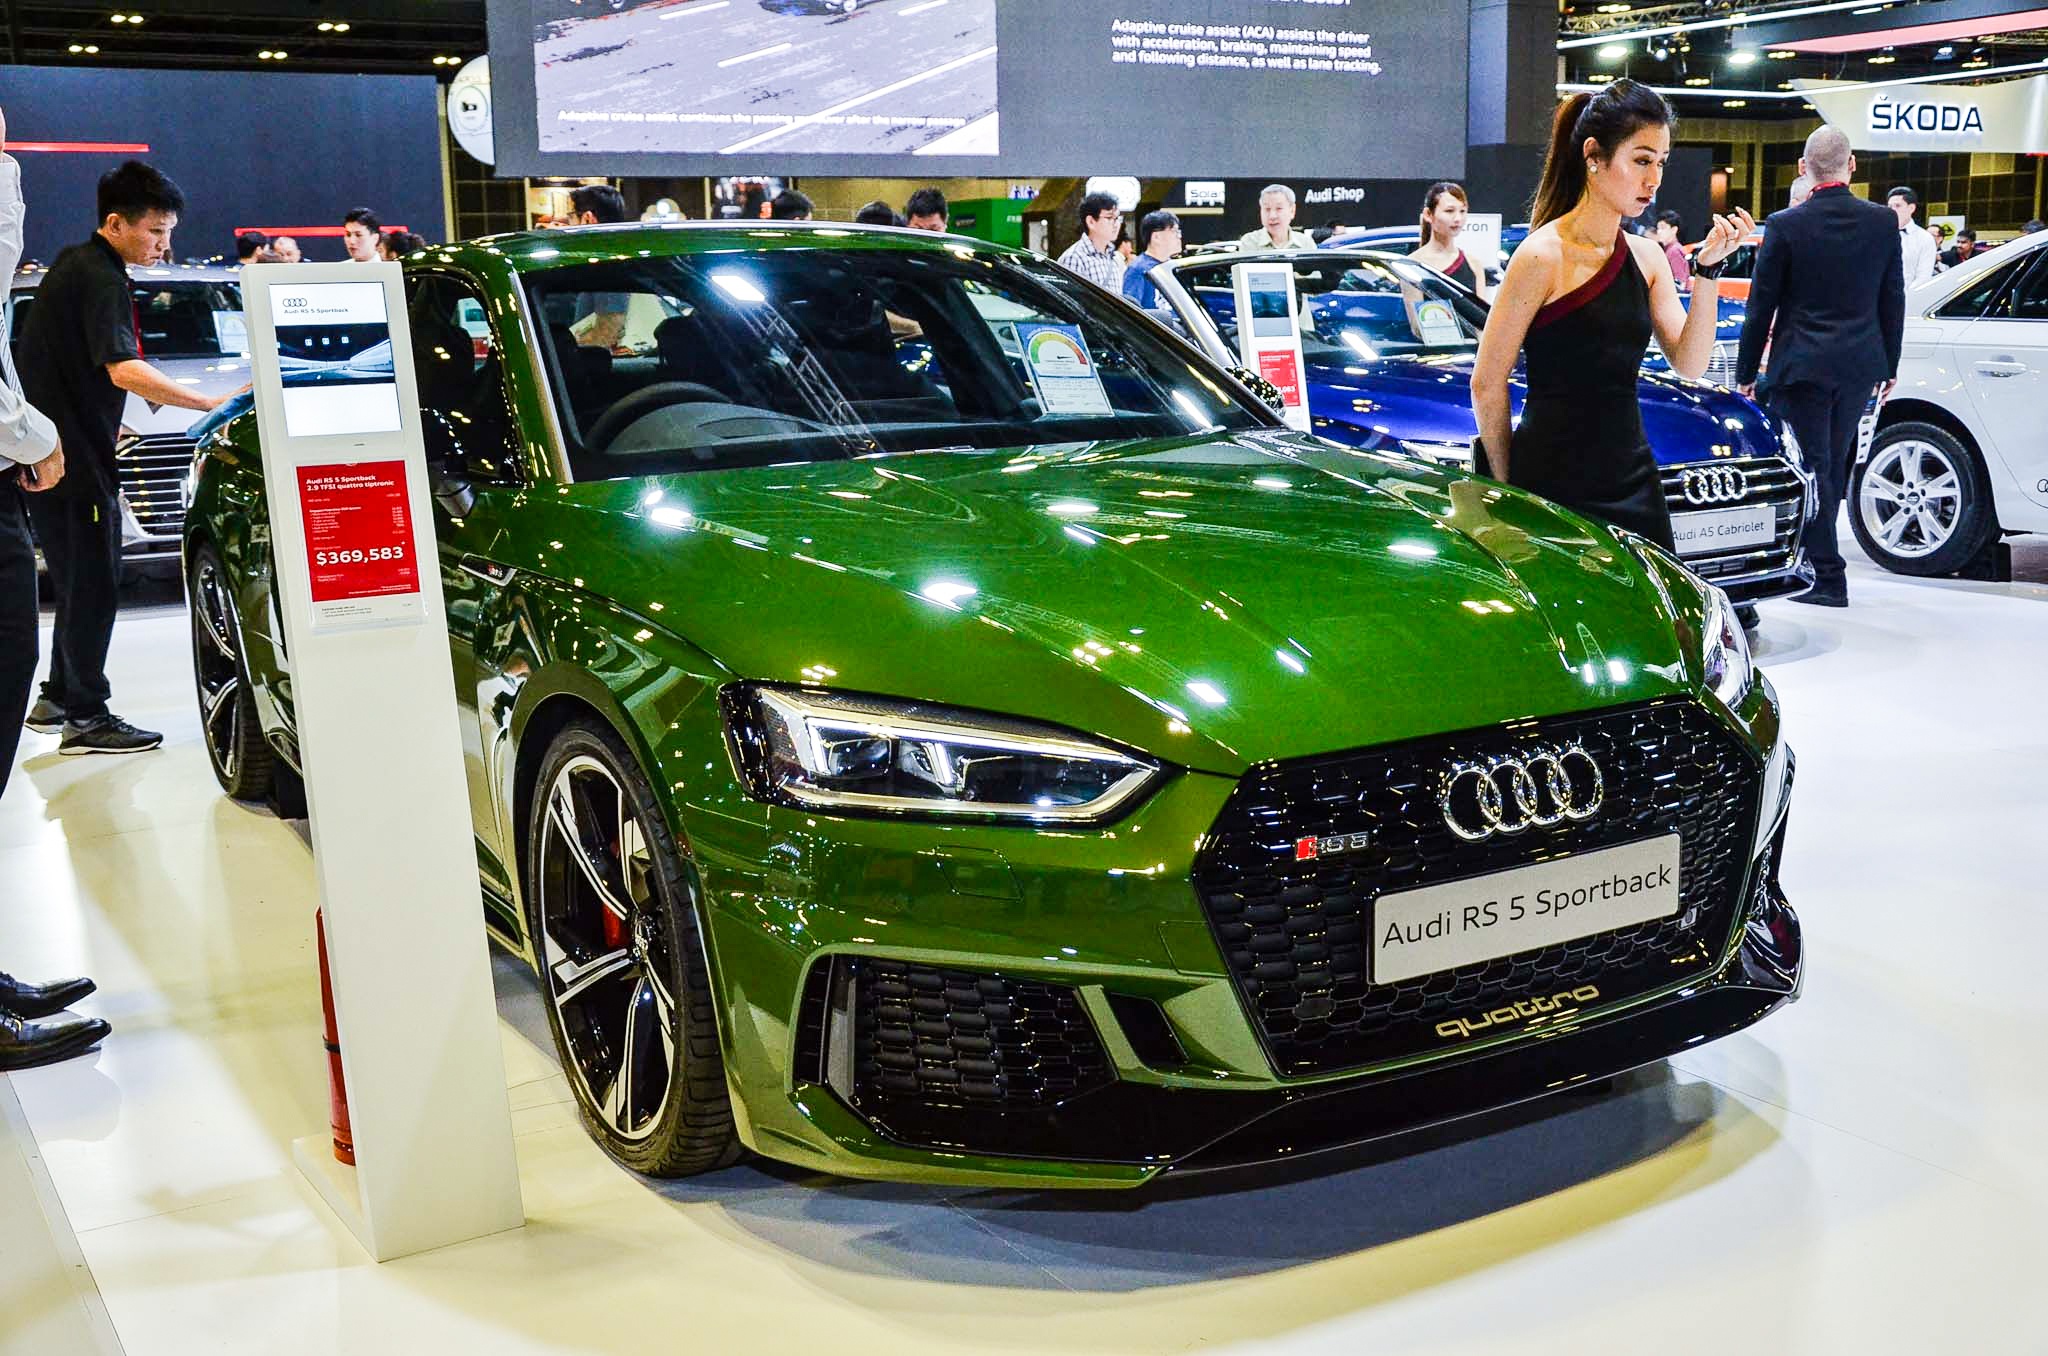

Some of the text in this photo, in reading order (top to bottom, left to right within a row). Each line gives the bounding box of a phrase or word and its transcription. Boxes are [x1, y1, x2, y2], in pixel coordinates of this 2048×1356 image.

[1112, 19, 1370, 44] Adaptive cruise assist (ACA) assists the driver
[1112, 35, 1371, 59] with acceleration, braking, maintaining speed
[1112, 50, 1382, 76] and following distance, as well as lane tracking.
[1872, 95, 1983, 131] ŠKODA
[1305, 187, 1365, 203] Audi Shop
[1462, 222, 1489, 232] ron
[306, 479, 395, 492] 2.9 TFSI quattro tiptronic
[340, 474, 377, 483] Sportback
[1672, 521, 1765, 541] Audi A5 Cabriolet
[316, 546, 404, 566] $369,583
[1382, 863, 1672, 948] Audi RS 5 Sportback
[1435, 984, 1600, 1038] quattro
